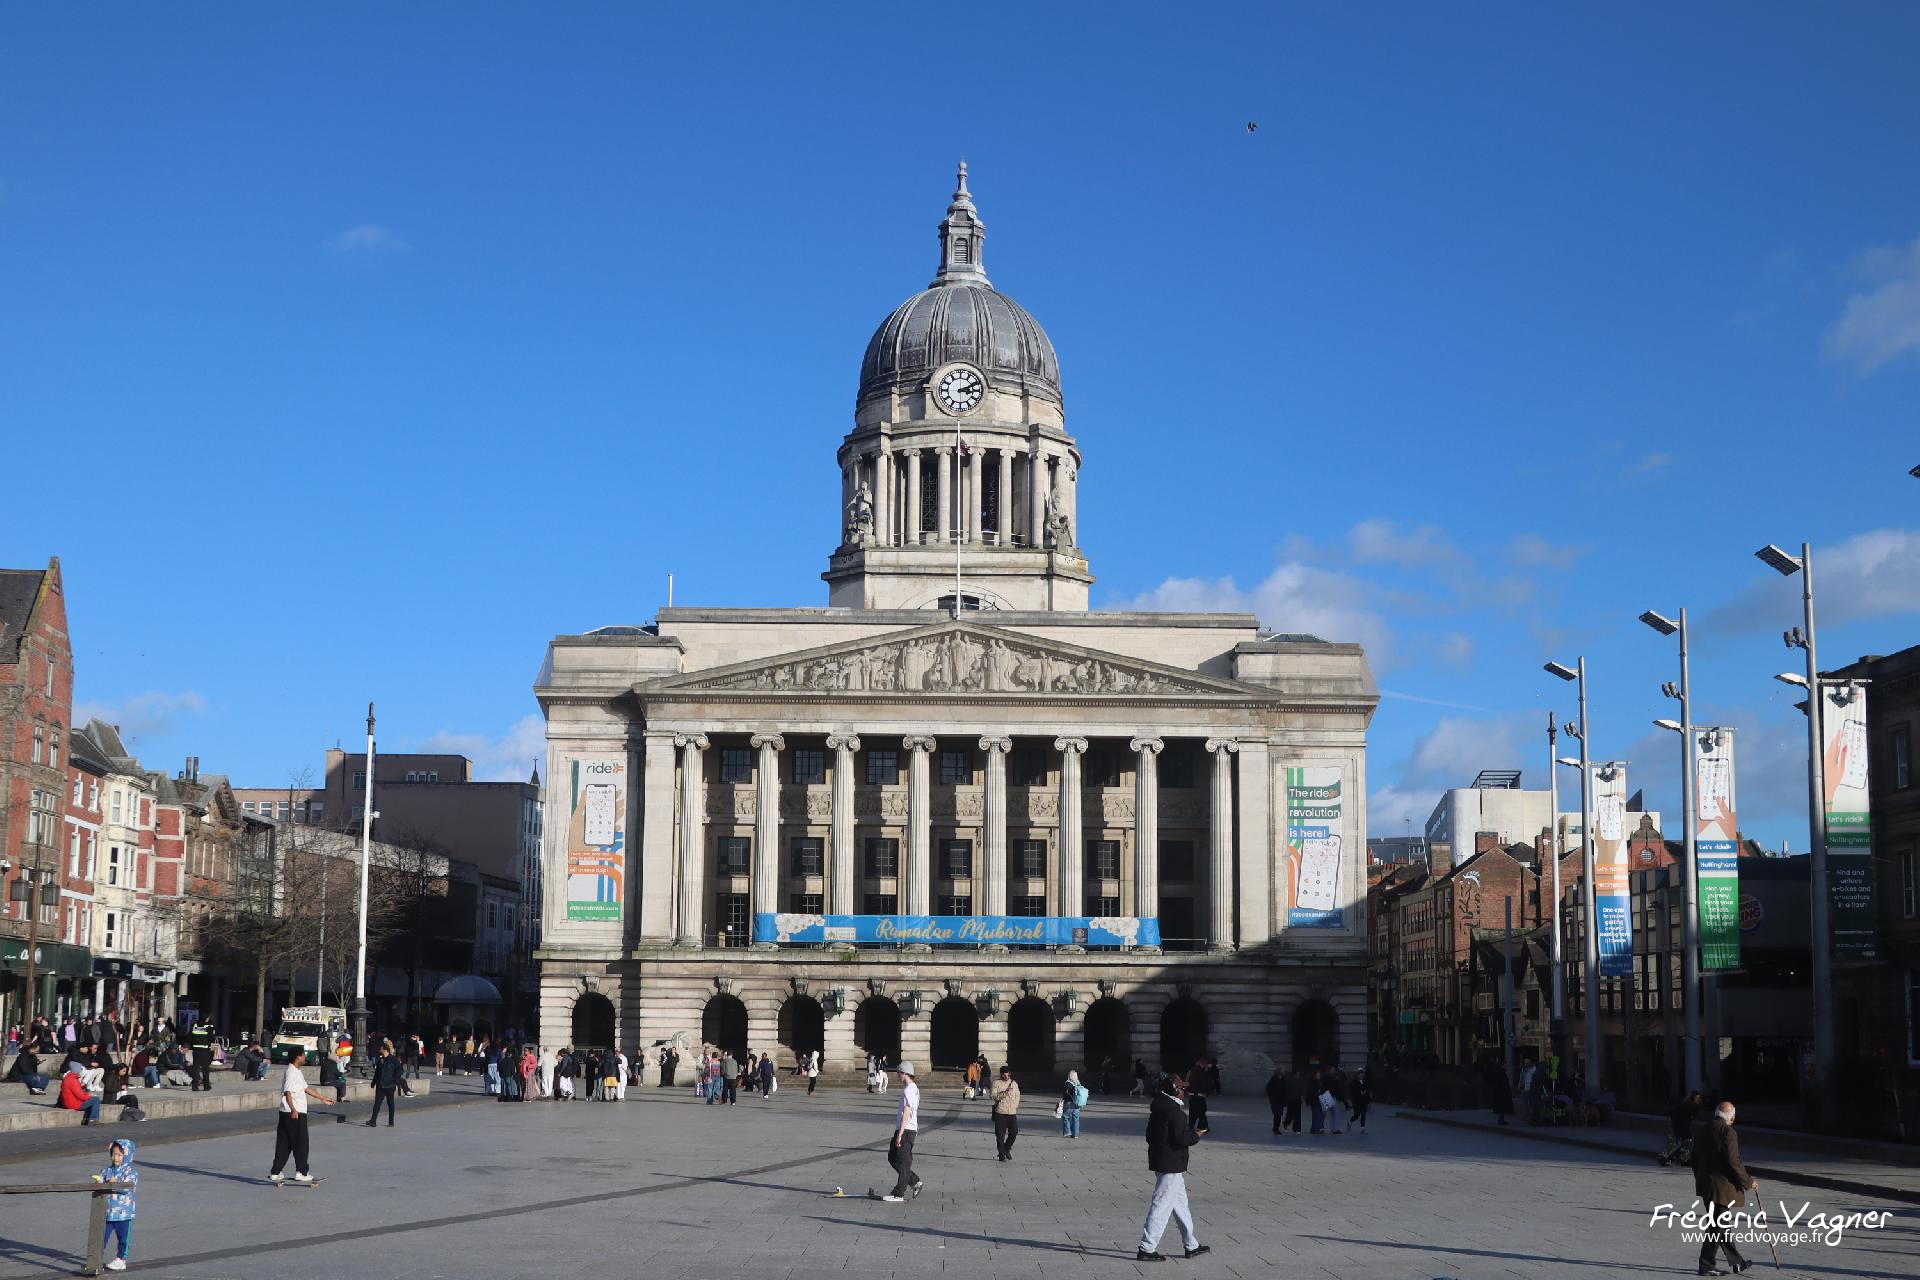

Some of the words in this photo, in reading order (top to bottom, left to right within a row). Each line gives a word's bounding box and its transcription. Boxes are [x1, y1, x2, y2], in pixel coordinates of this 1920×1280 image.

[586, 762, 612, 774] ride
[1289, 788, 1308, 798] The
[1309, 788, 1329, 798] ride
[1289, 807, 1341, 818] revolution
[1289, 827, 1298, 838] is
[1300, 827, 1326, 838] here!
[876, 918, 953, 940] Ramadan
[959, 918, 1044, 940] Mubarak
